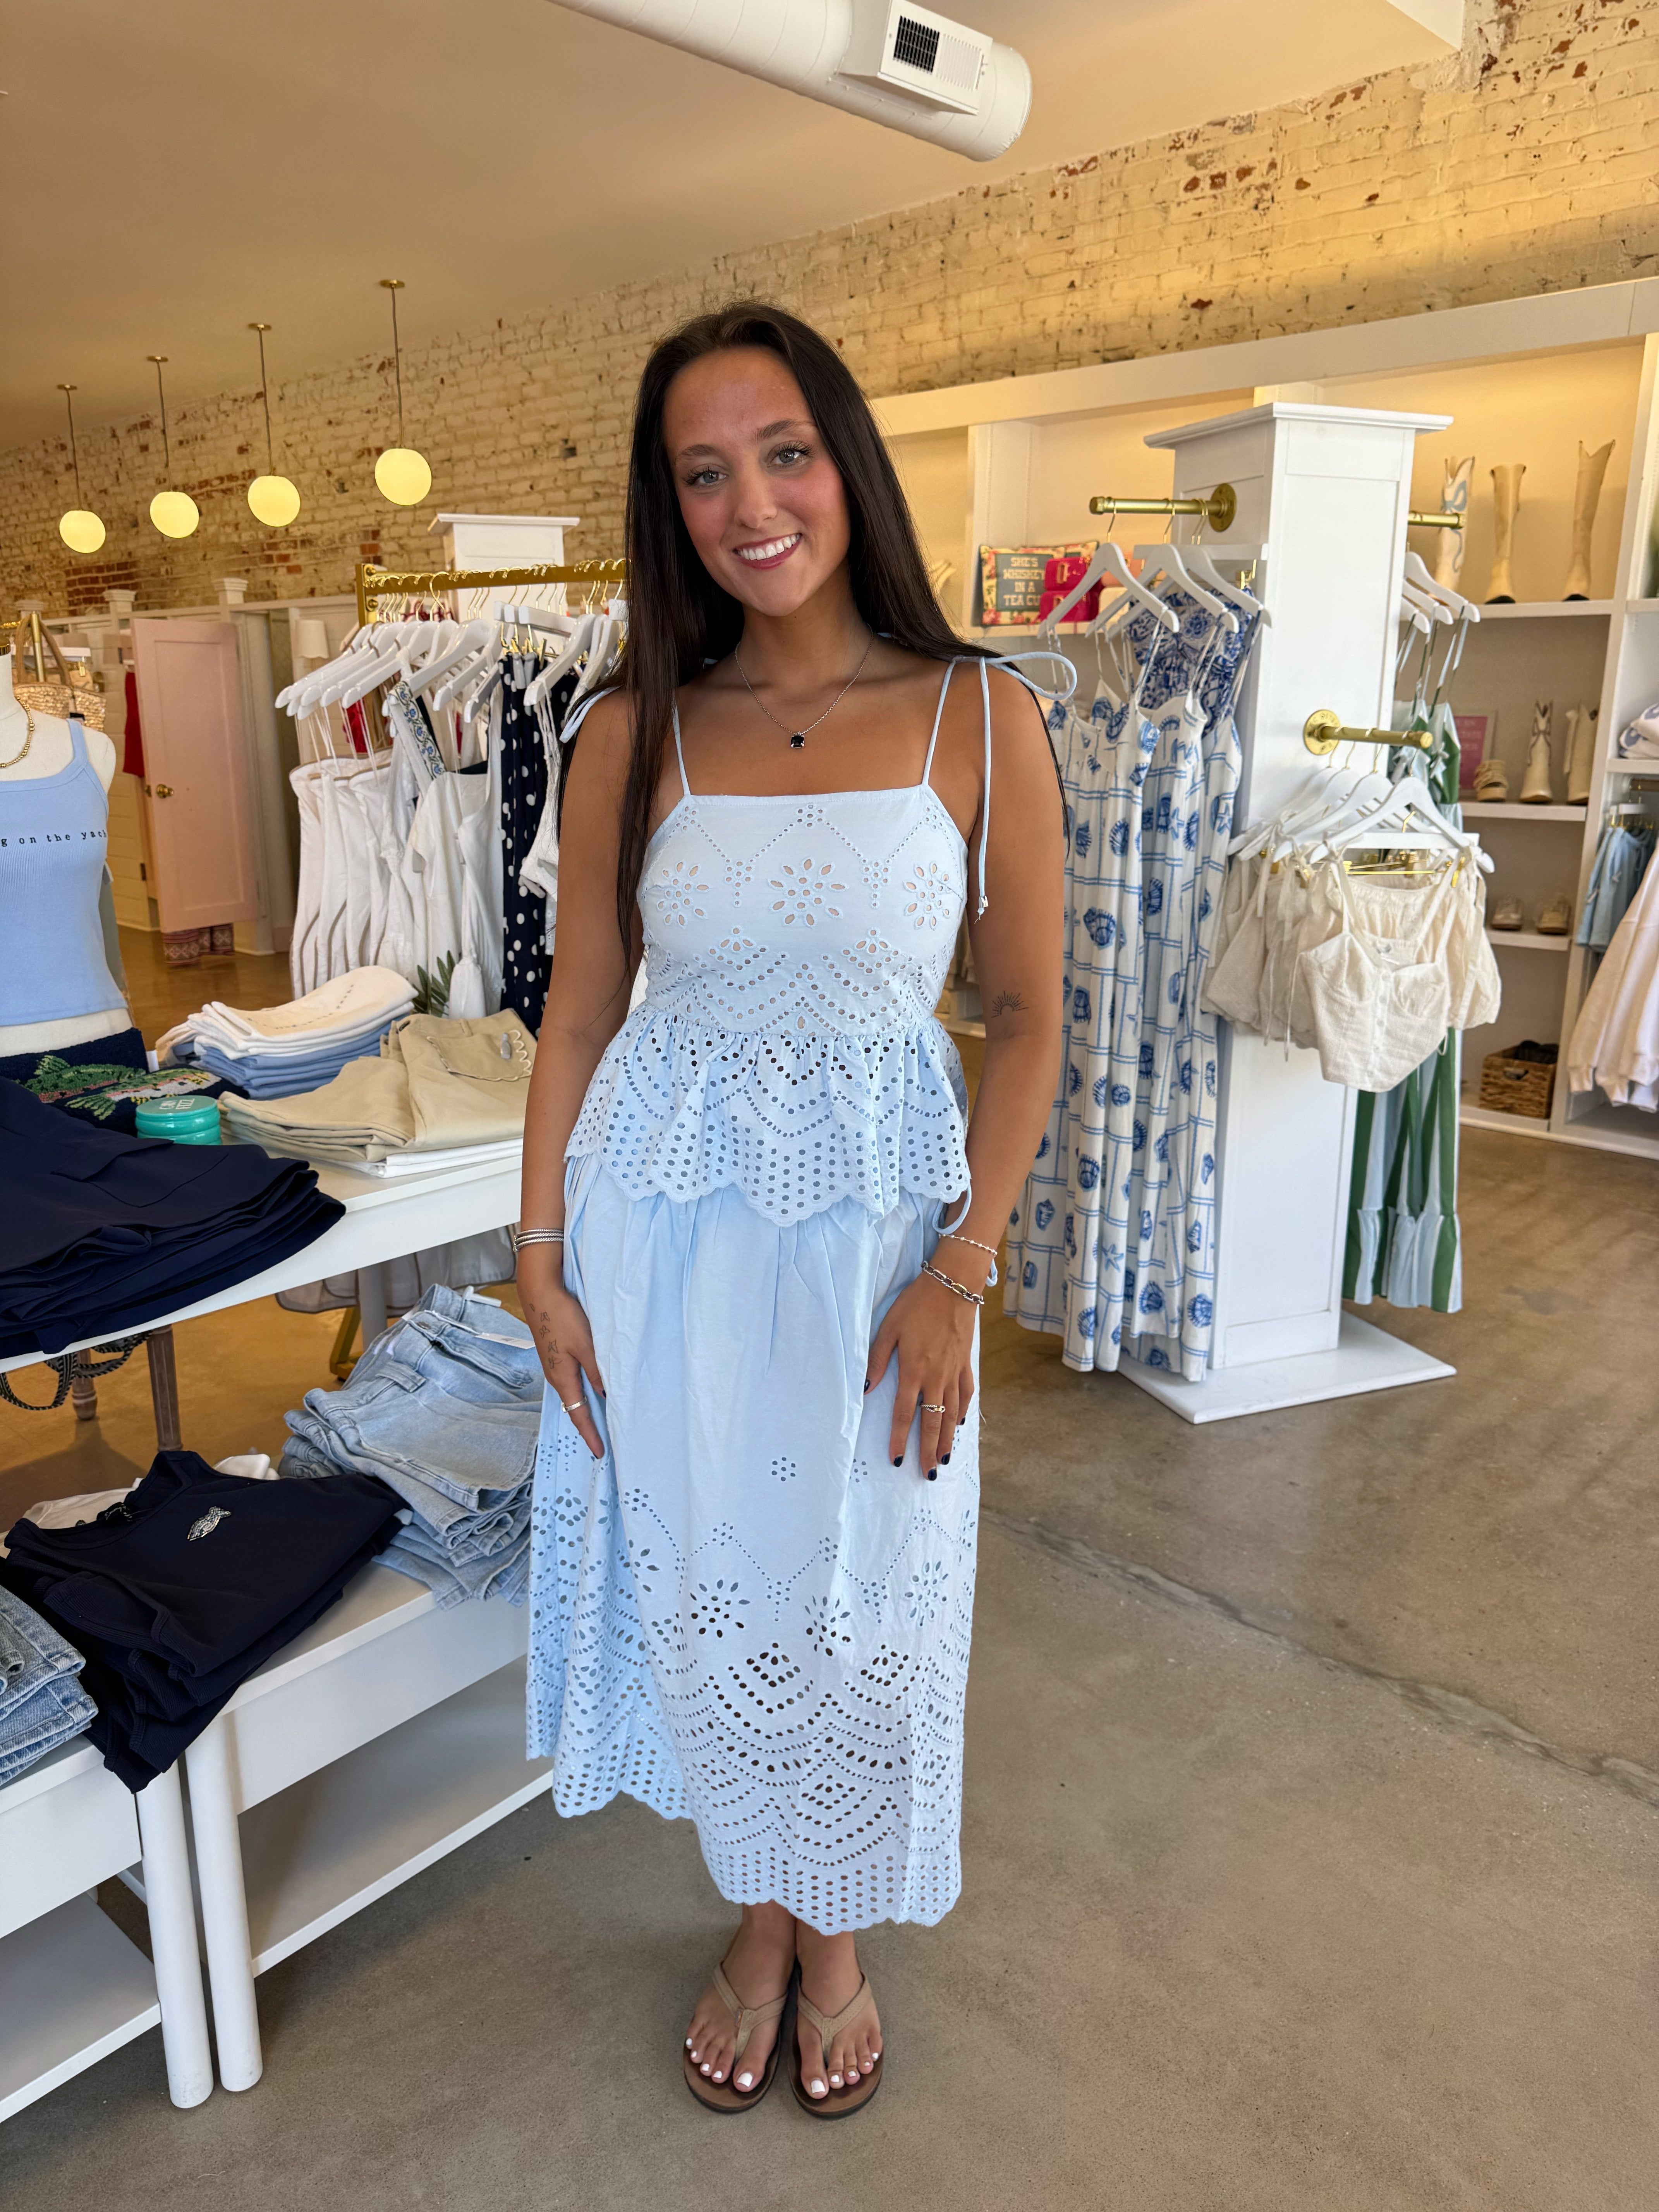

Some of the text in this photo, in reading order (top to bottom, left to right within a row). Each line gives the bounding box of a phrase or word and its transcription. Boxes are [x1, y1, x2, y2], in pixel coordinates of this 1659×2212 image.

[1015, 581, 1036, 592] IN A
[1003, 594, 1041, 606] TEA CU
[47, 834, 70, 842] the
